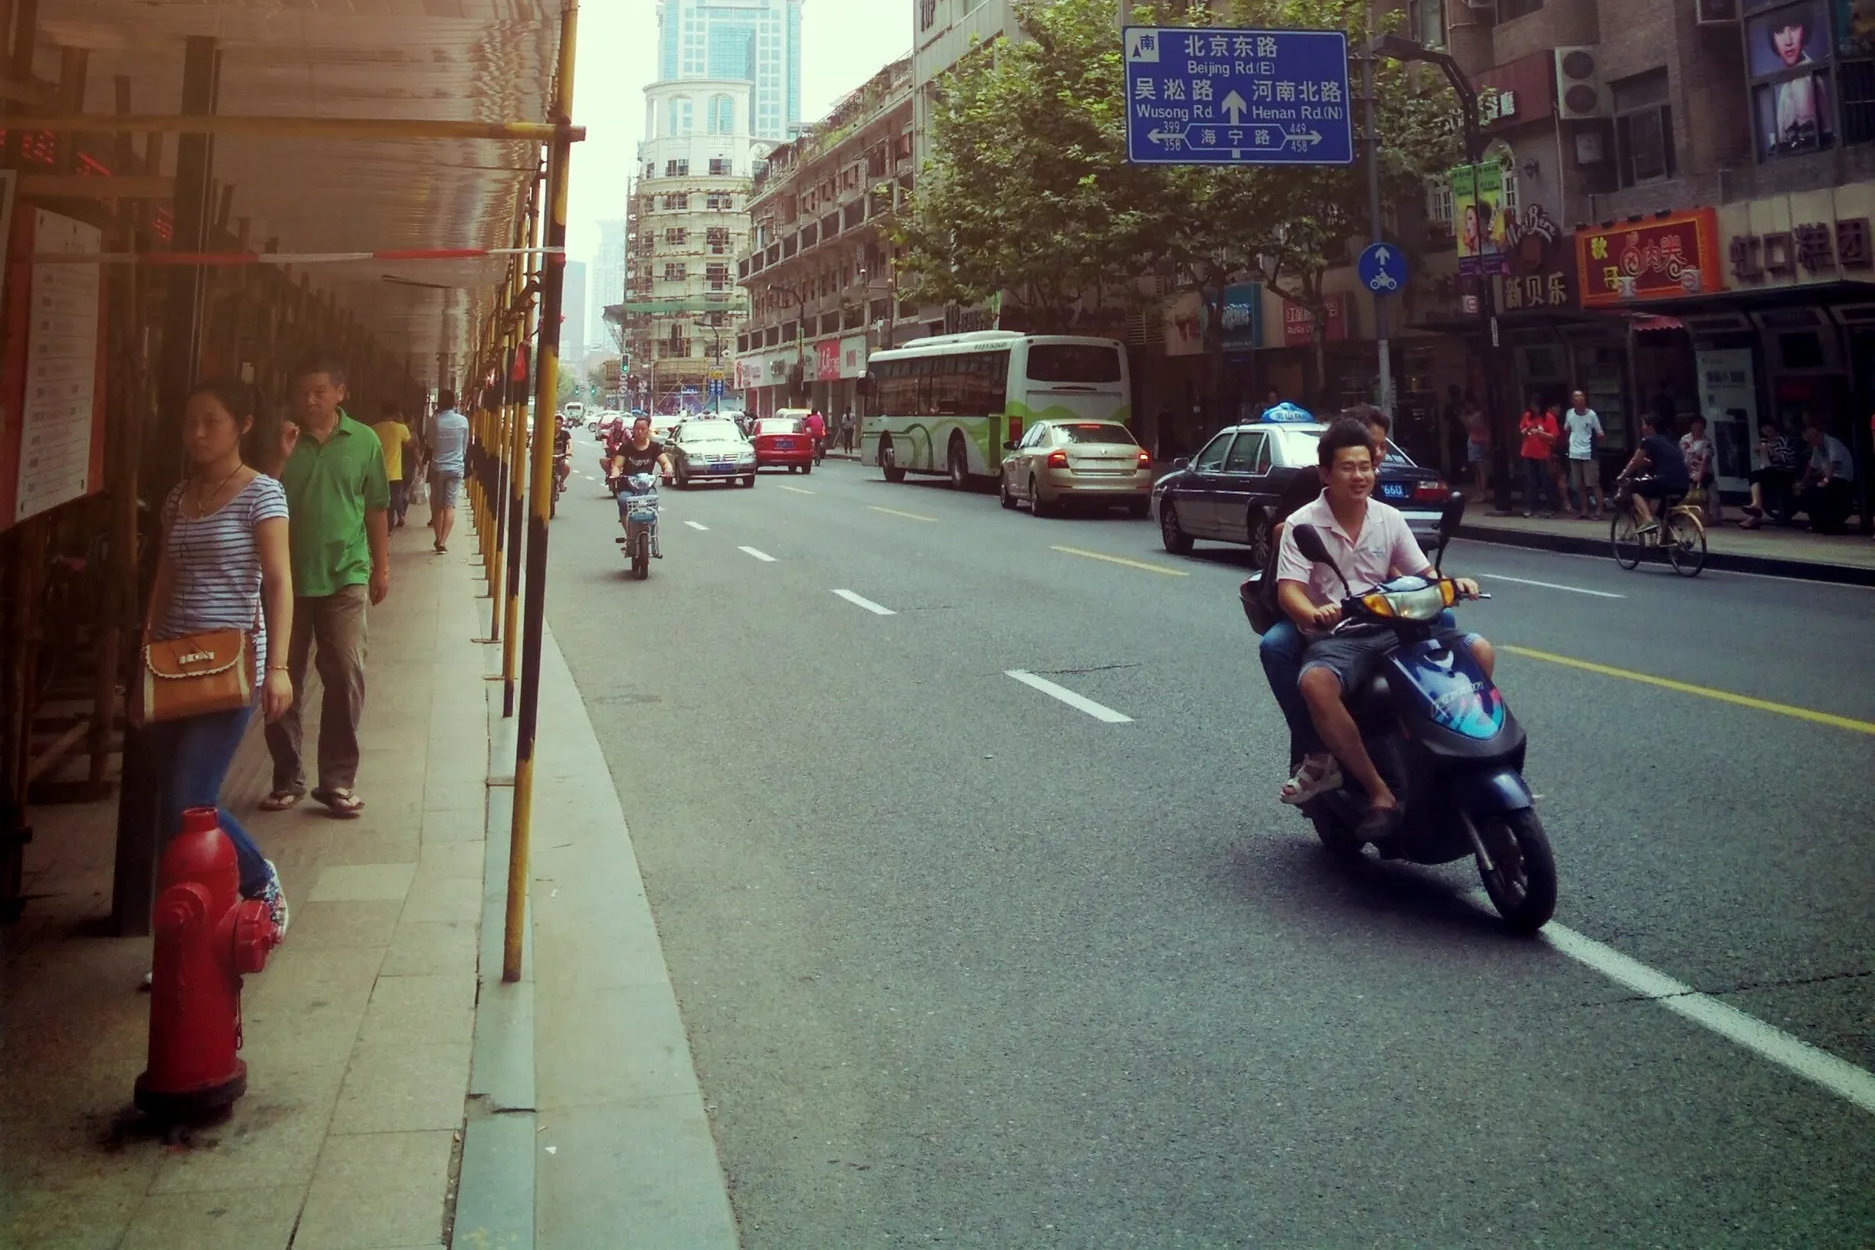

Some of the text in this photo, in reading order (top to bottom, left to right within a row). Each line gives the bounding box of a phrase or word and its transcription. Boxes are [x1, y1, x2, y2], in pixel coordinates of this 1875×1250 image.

[1139, 34, 1155, 51] 南
[1184, 35, 1278, 58] 北京东路
[1187, 61, 1230, 77] Beijing
[1135, 78, 1214, 101] 吴淞路
[1252, 79, 1342, 103] 河南北路
[1136, 104, 1189, 121] Wusong
[1252, 106, 1296, 120] Henan
[1163, 122, 1180, 134] 399
[1290, 123, 1307, 135] 449
[1163, 139, 1181, 151] 358
[1201, 129, 1271, 146] 海宁路
[1290, 141, 1308, 152] 458
